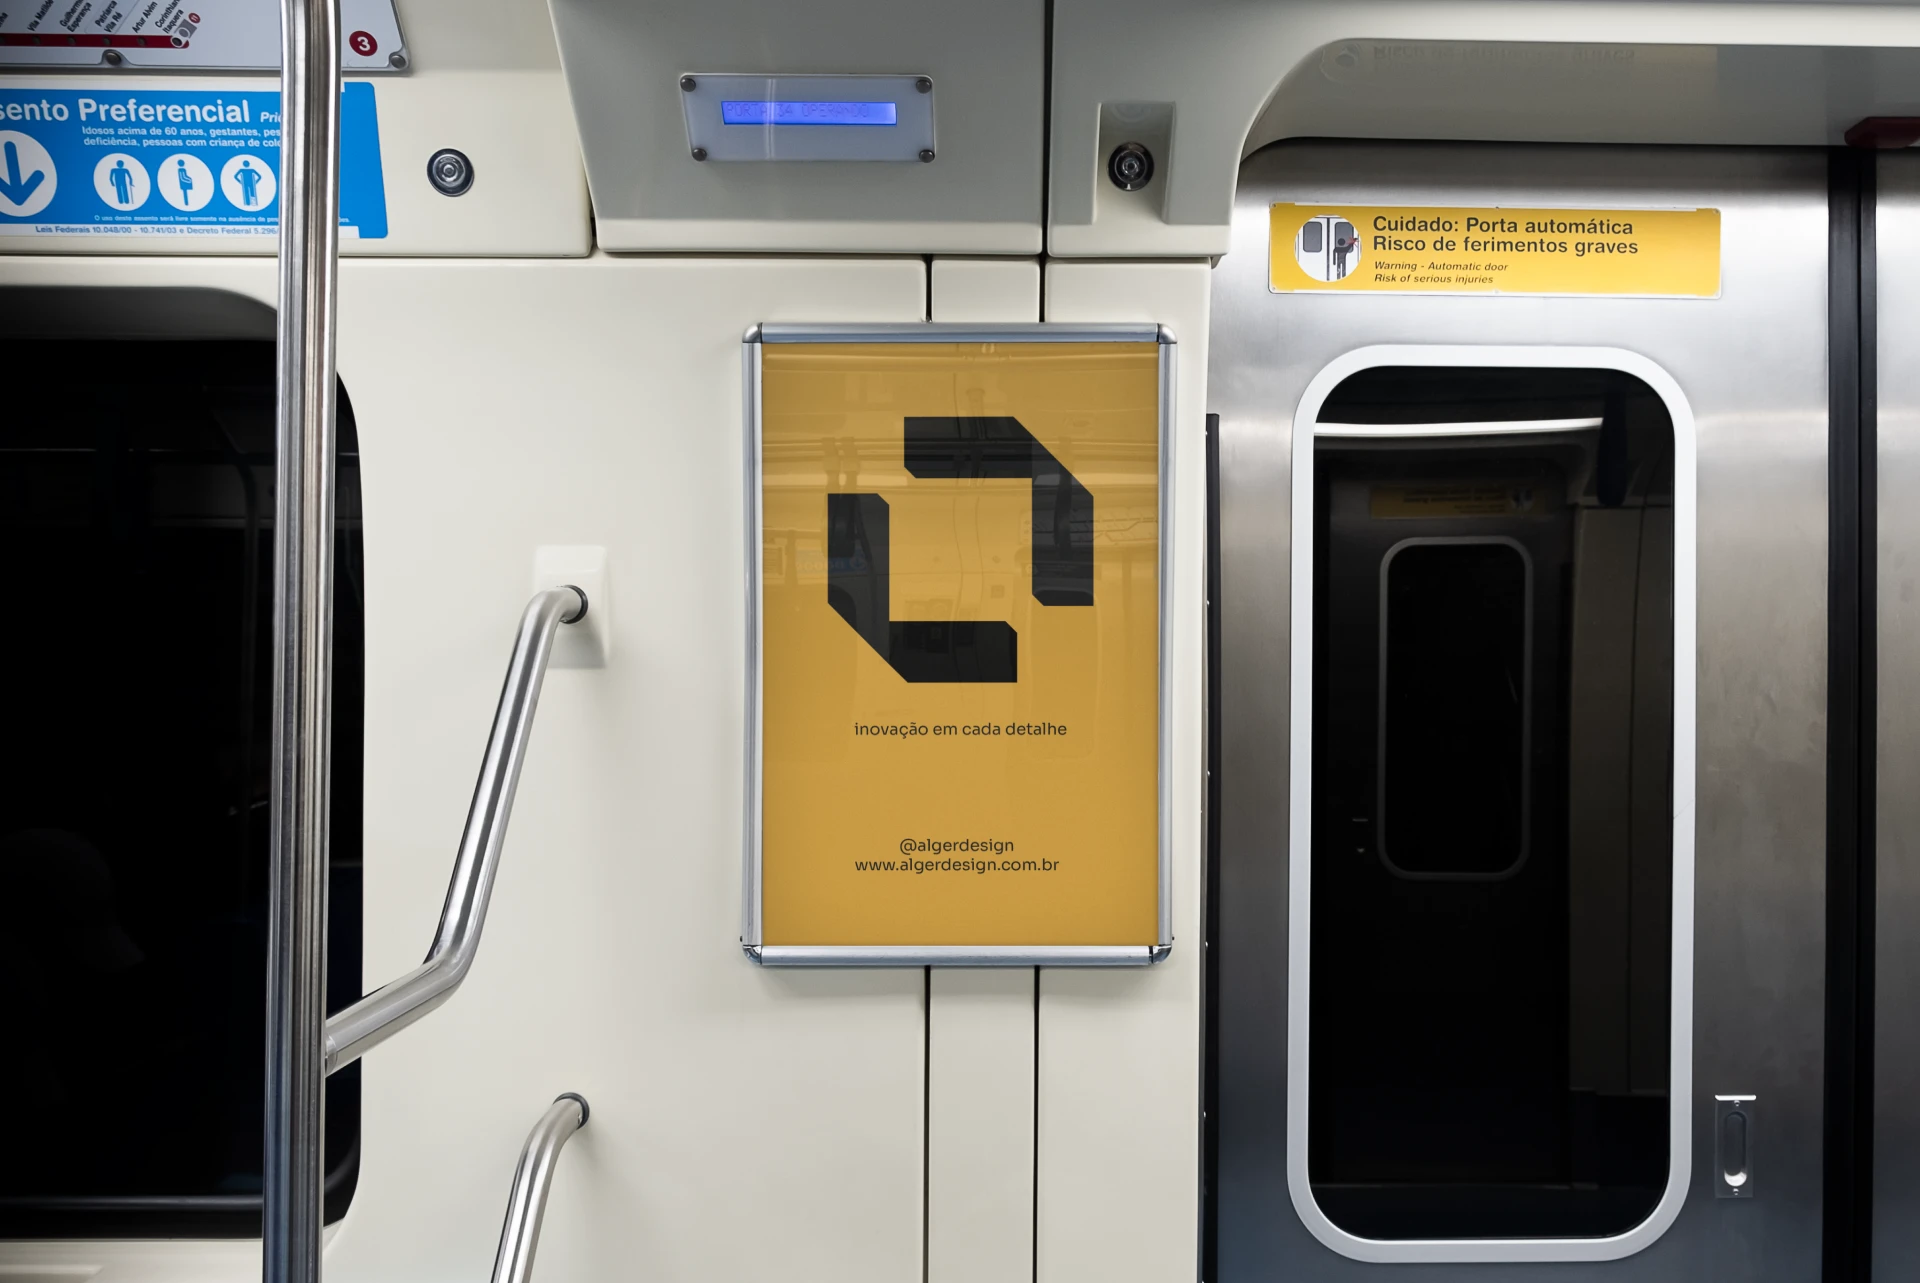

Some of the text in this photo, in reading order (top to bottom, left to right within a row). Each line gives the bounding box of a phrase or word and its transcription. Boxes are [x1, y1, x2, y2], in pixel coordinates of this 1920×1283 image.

[66, 2, 92, 32] Esperança
[95, 0, 118, 26] Patriarca
[132, 1, 158, 33] Artur Alvim
[162, 9, 184, 34] Itaquera
[104, 21, 117, 33] Vila
[357, 36, 371, 51] 3
[78, 98, 250, 123] Preferencial
[727, 103, 767, 117] PORTA
[82, 126, 115, 135] Idosos
[118, 126, 147, 136] acima
[150, 127, 162, 136] de
[165, 127, 178, 136] 60
[180, 129, 207, 137] anos,
[209, 128, 261, 138] gestantes,
[83, 137, 140, 147] deficiência,
[142, 139, 183, 147] pessoas
[186, 139, 207, 147] com
[209, 138, 245, 148] criança
[248, 138, 260, 147] de
[1373, 215, 1633, 235] Cuidado: Porta automática
[1373, 235, 1638, 257] Risco de ferimentos graves
[1374, 261, 1417, 272] Warning
[1427, 261, 1481, 271] Automatic
[1484, 262, 1509, 271] door
[1374, 273, 1494, 285] Risk of serious injuries
[855, 722, 1067, 739] inovação em cada detalhe
[900, 838, 1014, 855] @algerdesign
[855, 858, 1060, 874] www.algerdesign.com.br
